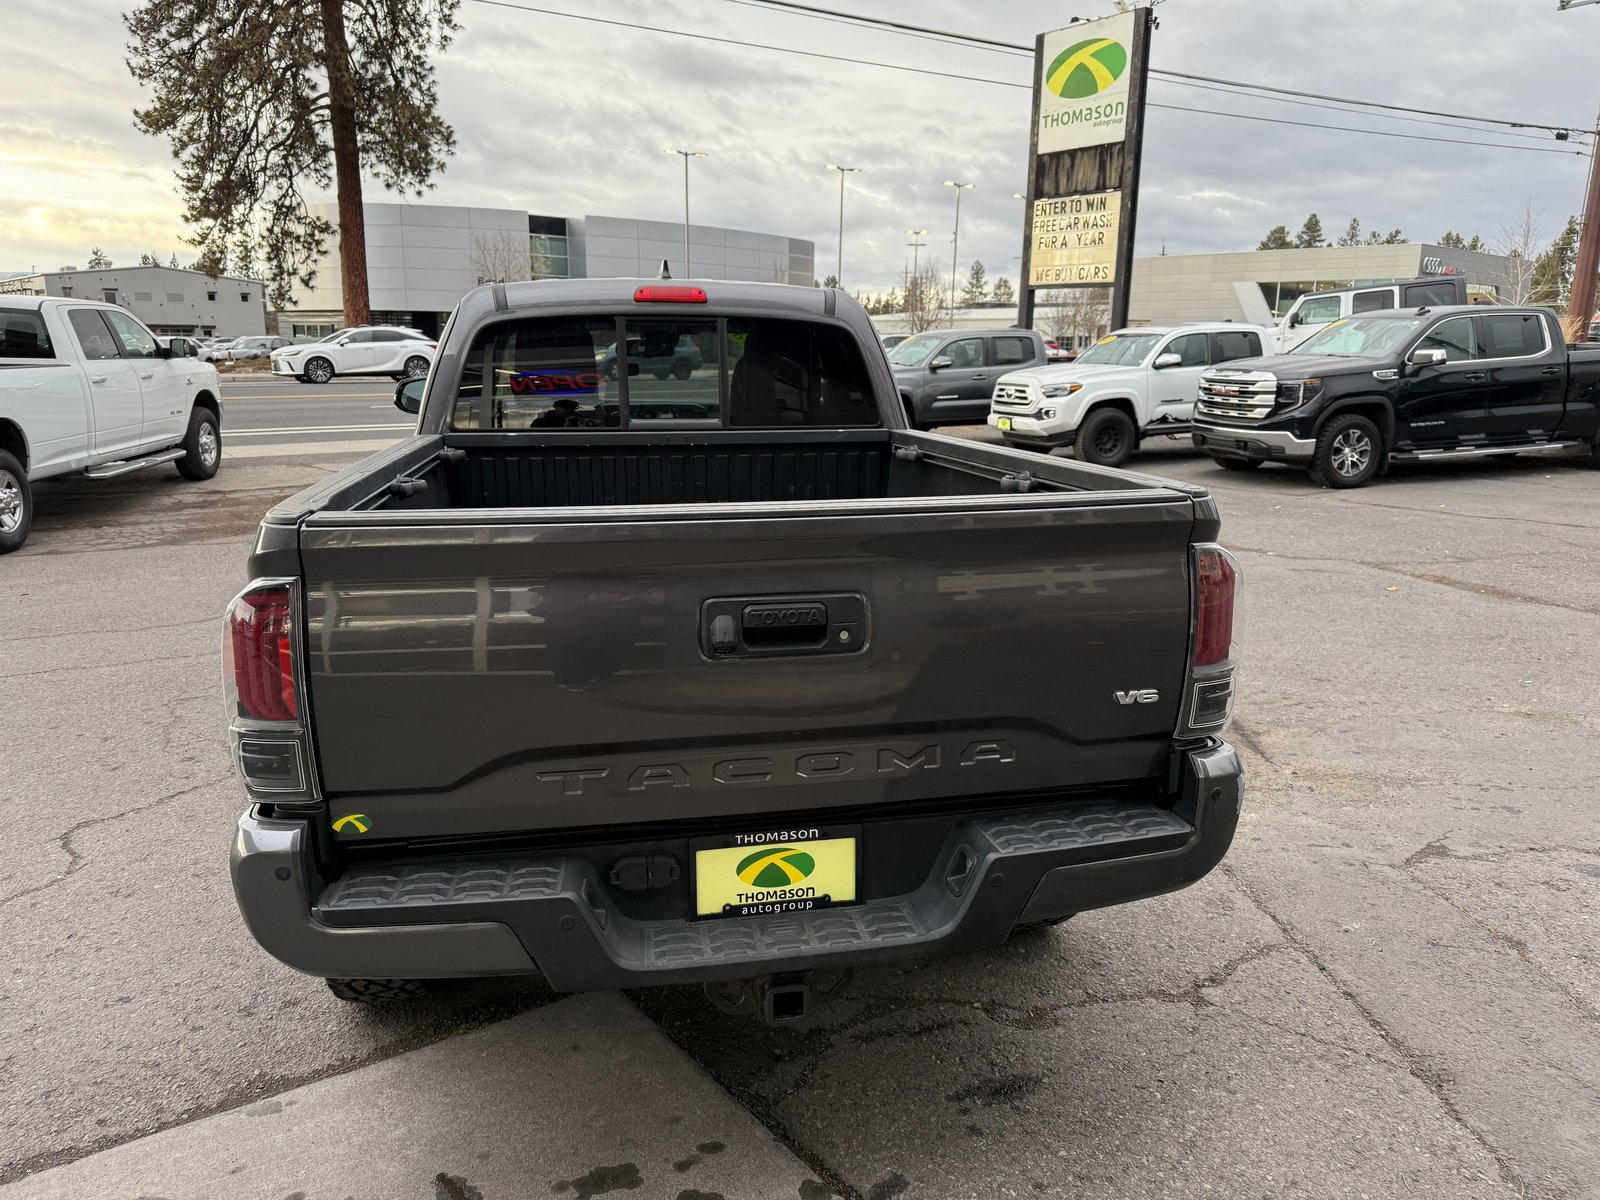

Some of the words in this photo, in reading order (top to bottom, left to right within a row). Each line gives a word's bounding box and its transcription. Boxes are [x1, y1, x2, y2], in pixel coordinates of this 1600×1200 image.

[1093, 117, 1124, 128] autogroup
[1035, 201, 1067, 217] ENTER
[1070, 199, 1082, 214] TO
[1086, 196, 1107, 212] WIN
[1034, 218, 1057, 233] FREE
[1059, 216, 1080, 231] CAR
[1082, 212, 1113, 230] WASH
[1038, 235, 1058, 249] FOR
[1060, 234, 1068, 248] A
[1076, 231, 1105, 247] YEAR
[1035, 268, 1051, 282] WE
[1078, 266, 1109, 280] CARS
[750, 609, 821, 626] TOYOTA
[1113, 689, 1160, 705] V6
[535, 738, 1017, 796] TACOMA
[741, 900, 814, 915] autogroup
